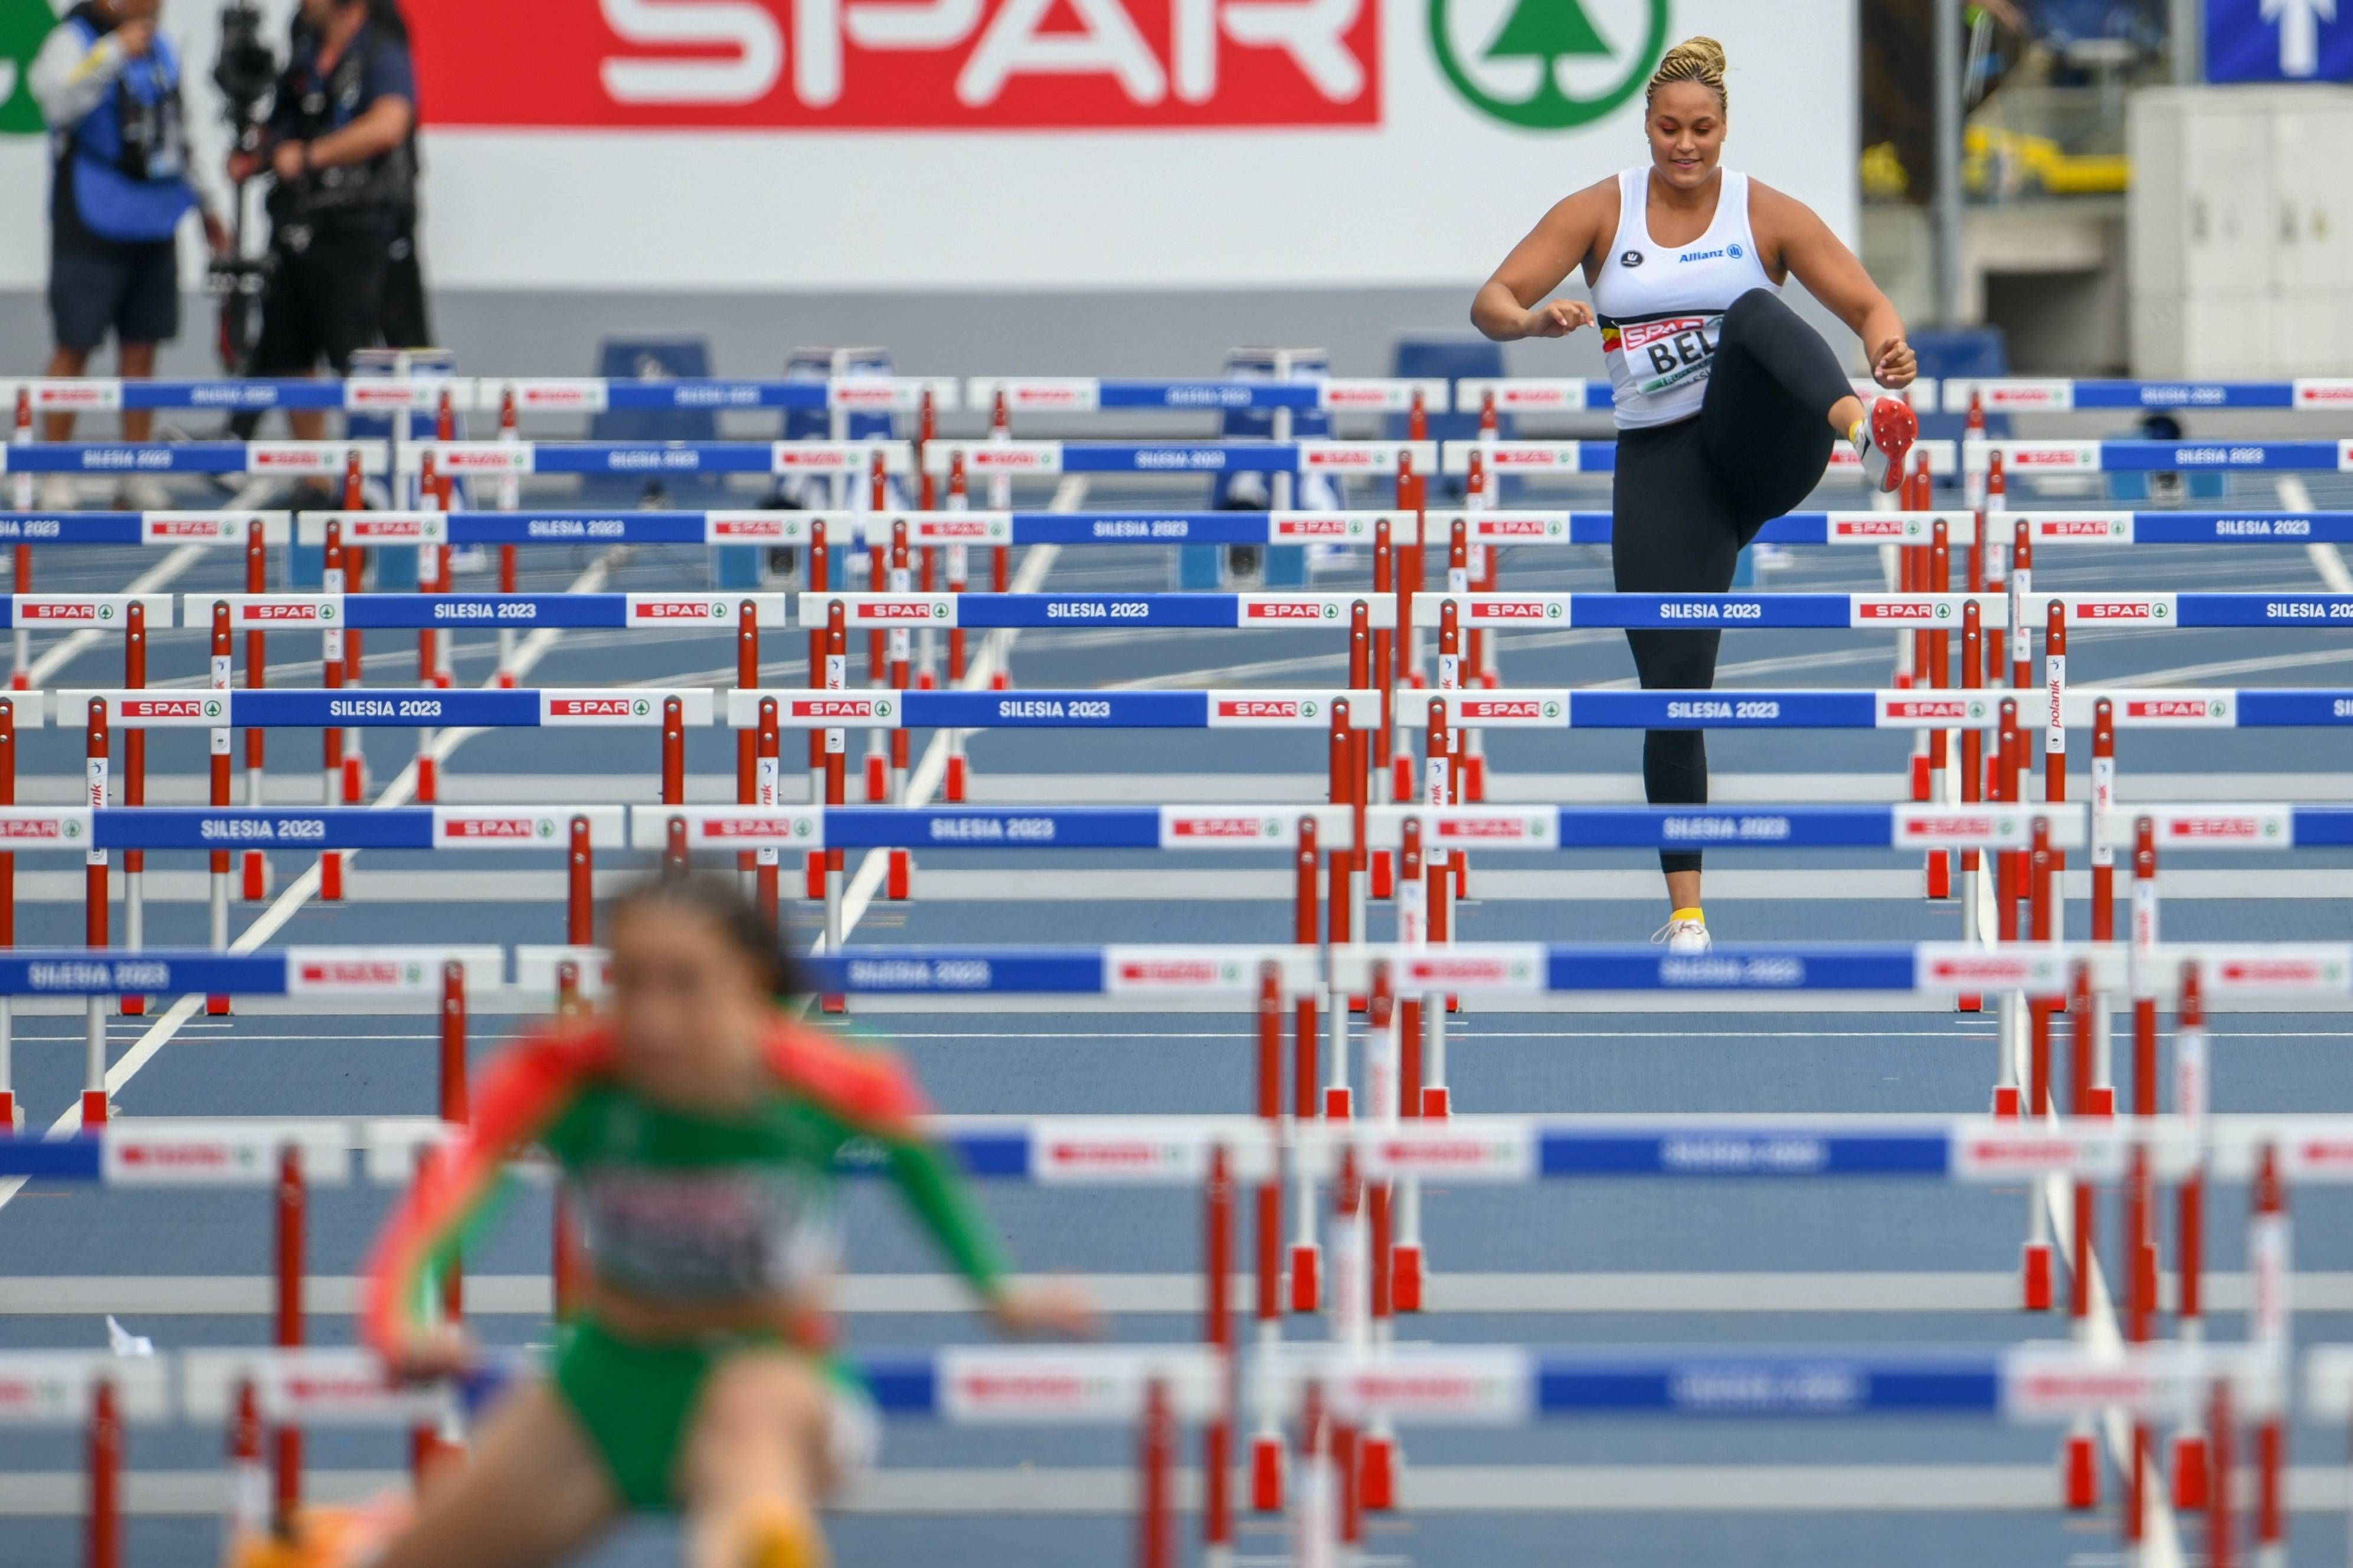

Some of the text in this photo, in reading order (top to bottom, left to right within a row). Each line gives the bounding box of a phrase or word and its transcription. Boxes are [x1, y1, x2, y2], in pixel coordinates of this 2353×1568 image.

[599, 0, 1365, 106] SPAR
[1679, 250, 1724, 263] Allianz
[1647, 330, 1715, 375] BEL
[529, 521, 624, 536] SILESIA 2023
[1094, 521, 1189, 536] SILESIA 2023
[1852, 523, 1902, 534] SPAR
[2056, 523, 2107, 534] SPAR
[2216, 520, 2310, 535] SILESIA 2023
[38, 605, 94, 618] SPAR
[260, 606, 315, 618] SPAR
[434, 603, 536, 618] SILESIA 2023
[652, 605, 708, 617] SPAR
[874, 605, 929, 617] SPAR
[1048, 603, 1148, 618] SILESIA 2023
[1264, 604, 1319, 617] SPAR
[1487, 604, 1543, 617] SPAR
[1660, 603, 1761, 618] SILESIA 2023
[1876, 605, 1932, 617] SPAR
[2093, 605, 2149, 617] SPAR
[2266, 603, 2326, 617] SILESIA
[140, 702, 200, 716] SPAR
[330, 700, 441, 716] SILESIA 2023
[568, 701, 629, 715] SPAR
[810, 702, 870, 716] SPAR
[1000, 701, 1110, 718] SILESIA 2023
[1236, 702, 1296, 716] SPAR
[1479, 703, 1539, 716] SPAR
[1667, 702, 1779, 719] SILESIA 2023
[1904, 703, 1964, 716] SPAR
[2049, 679, 2061, 728] polanik
[2145, 702, 2205, 716] SPAR
[201, 820, 325, 838] SILESIA 2023
[464, 821, 530, 836] SPAR
